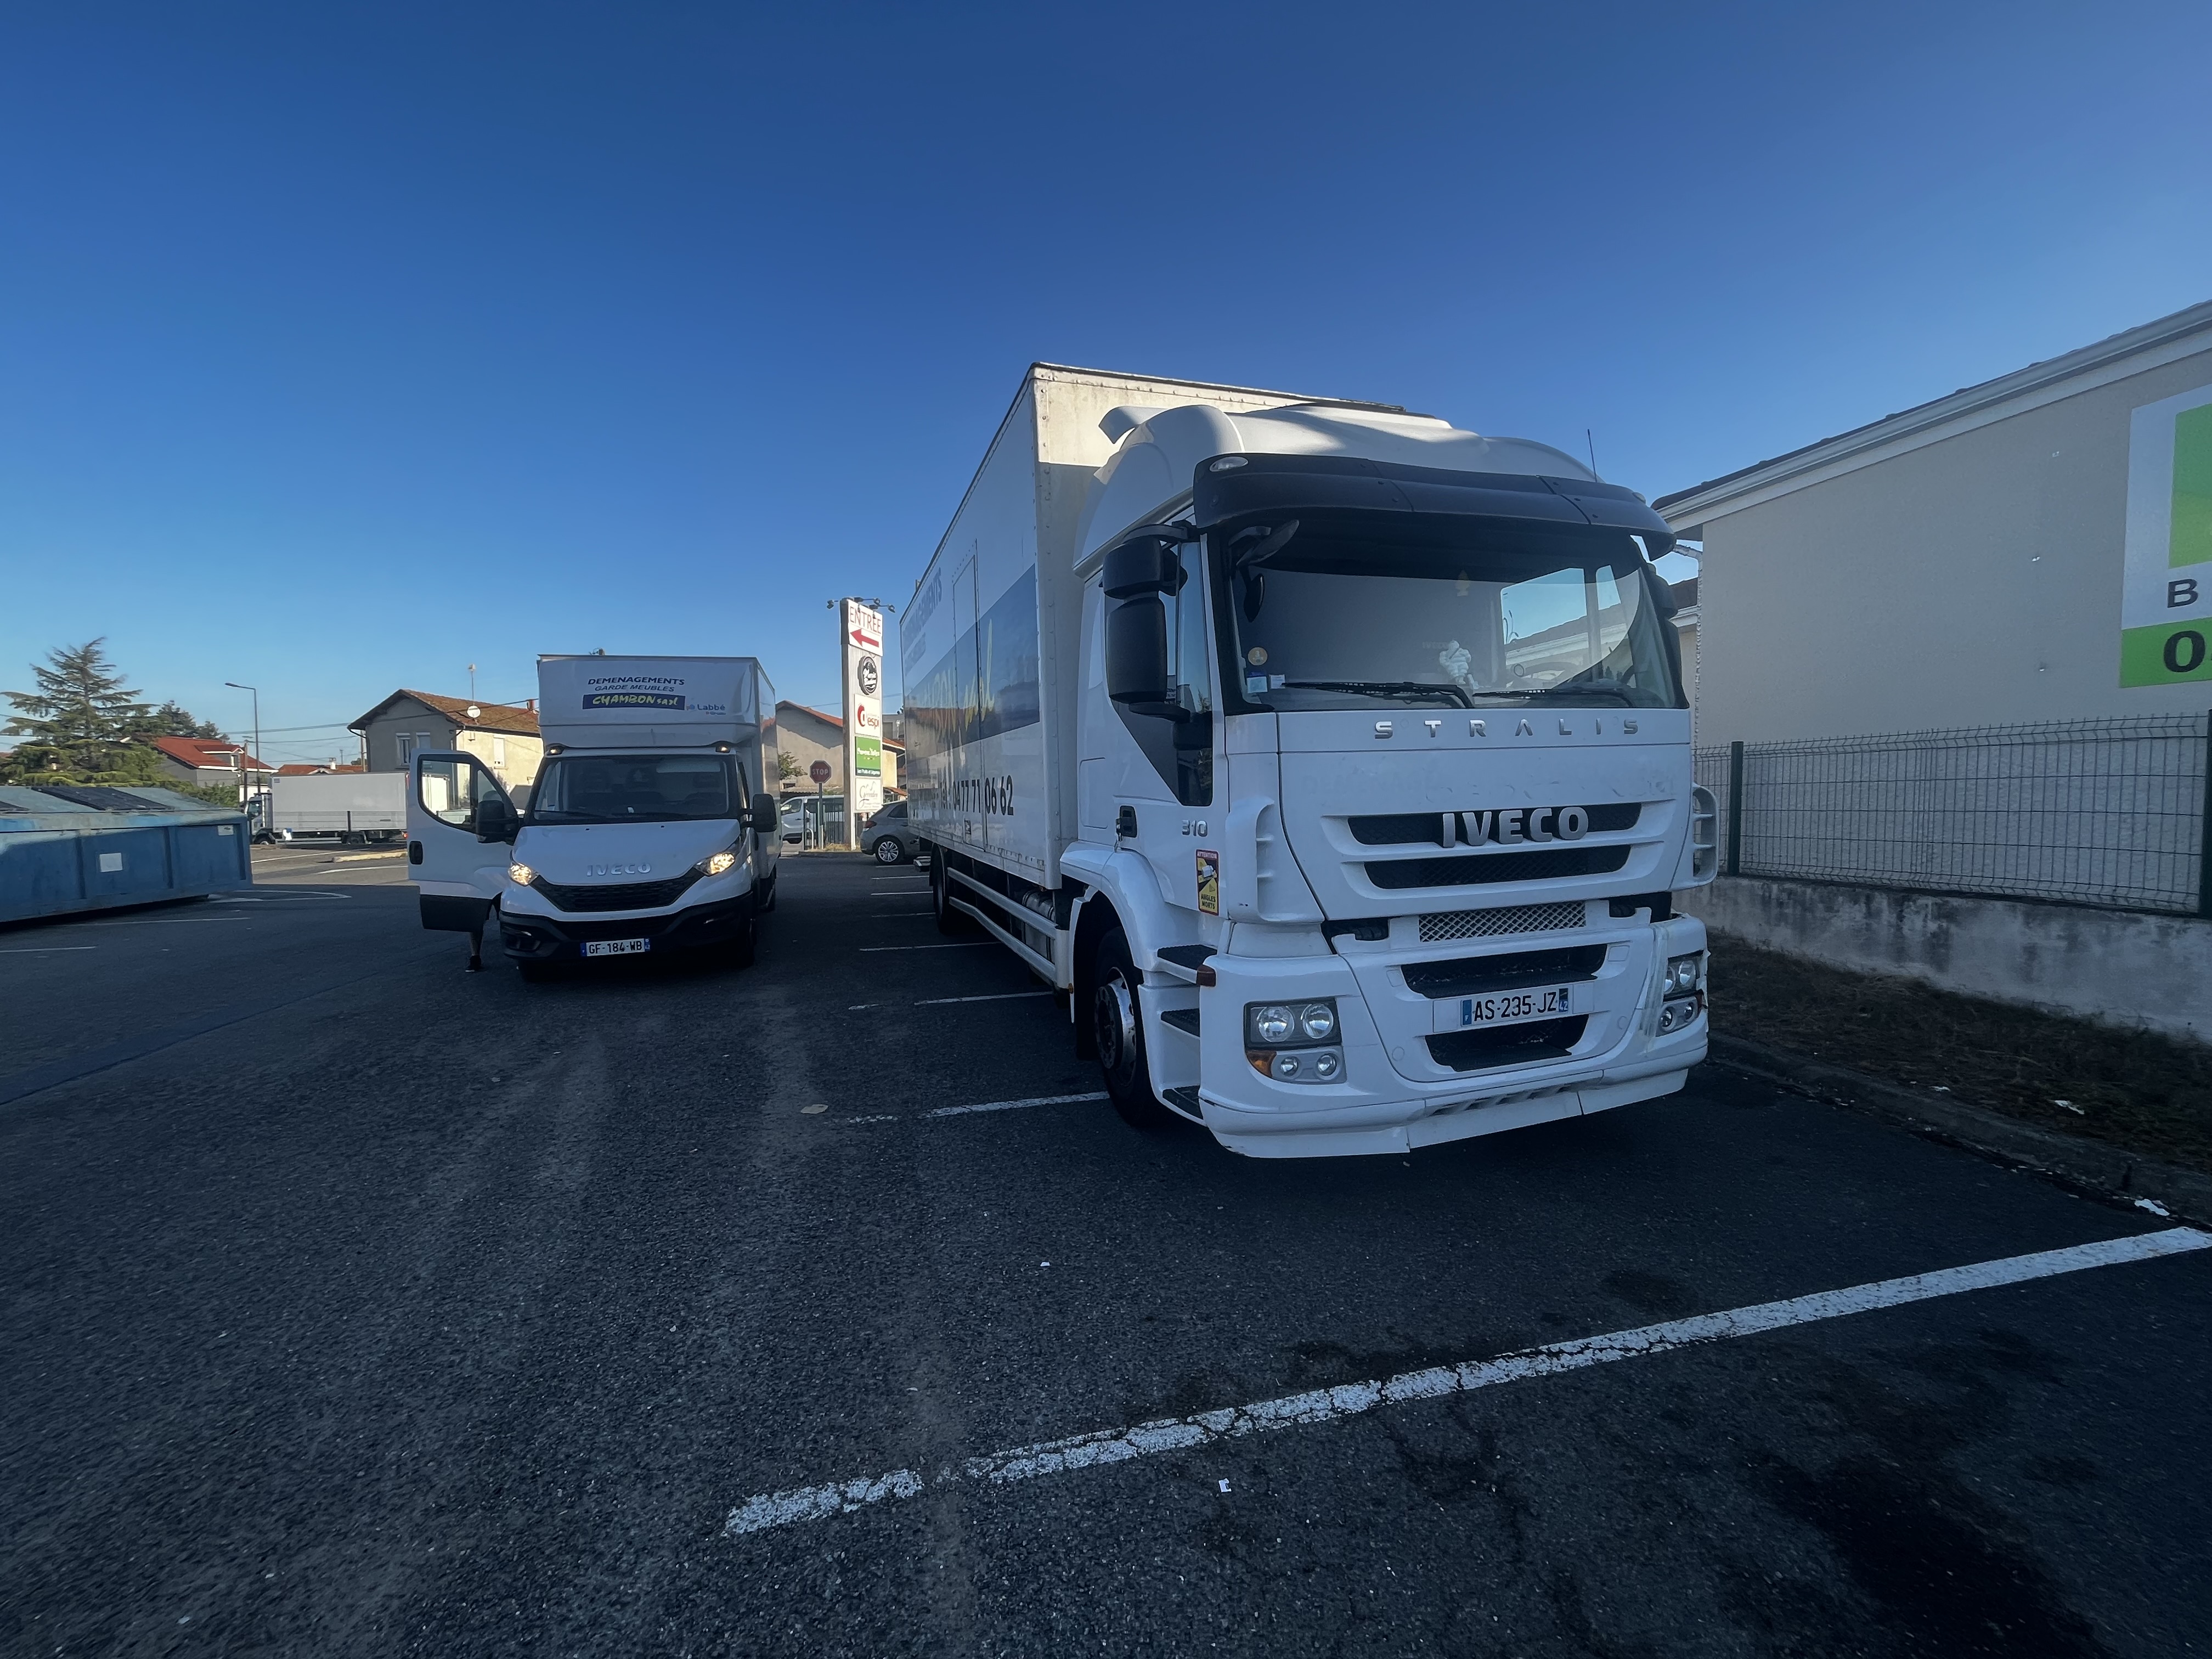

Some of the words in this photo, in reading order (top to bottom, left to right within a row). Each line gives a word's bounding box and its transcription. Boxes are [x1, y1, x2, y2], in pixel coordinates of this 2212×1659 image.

[588, 676, 685, 685] DEMENAGEMENTS
[592, 695, 656, 706] CHAMBON
[657, 697, 678, 706] sarl
[1374, 718, 1638, 739] STRALIS
[961, 780, 969, 812] 77
[972, 779, 981, 814] 71
[985, 777, 997, 815] 06
[1000, 775, 1014, 816] 62
[1182, 819, 1207, 837] 310
[1442, 806, 1589, 848] IVECO
[586, 863, 651, 876] IVECO
[589, 940, 642, 954] GF-184-WB
[1474, 991, 1556, 1022] AS-235-JZ
